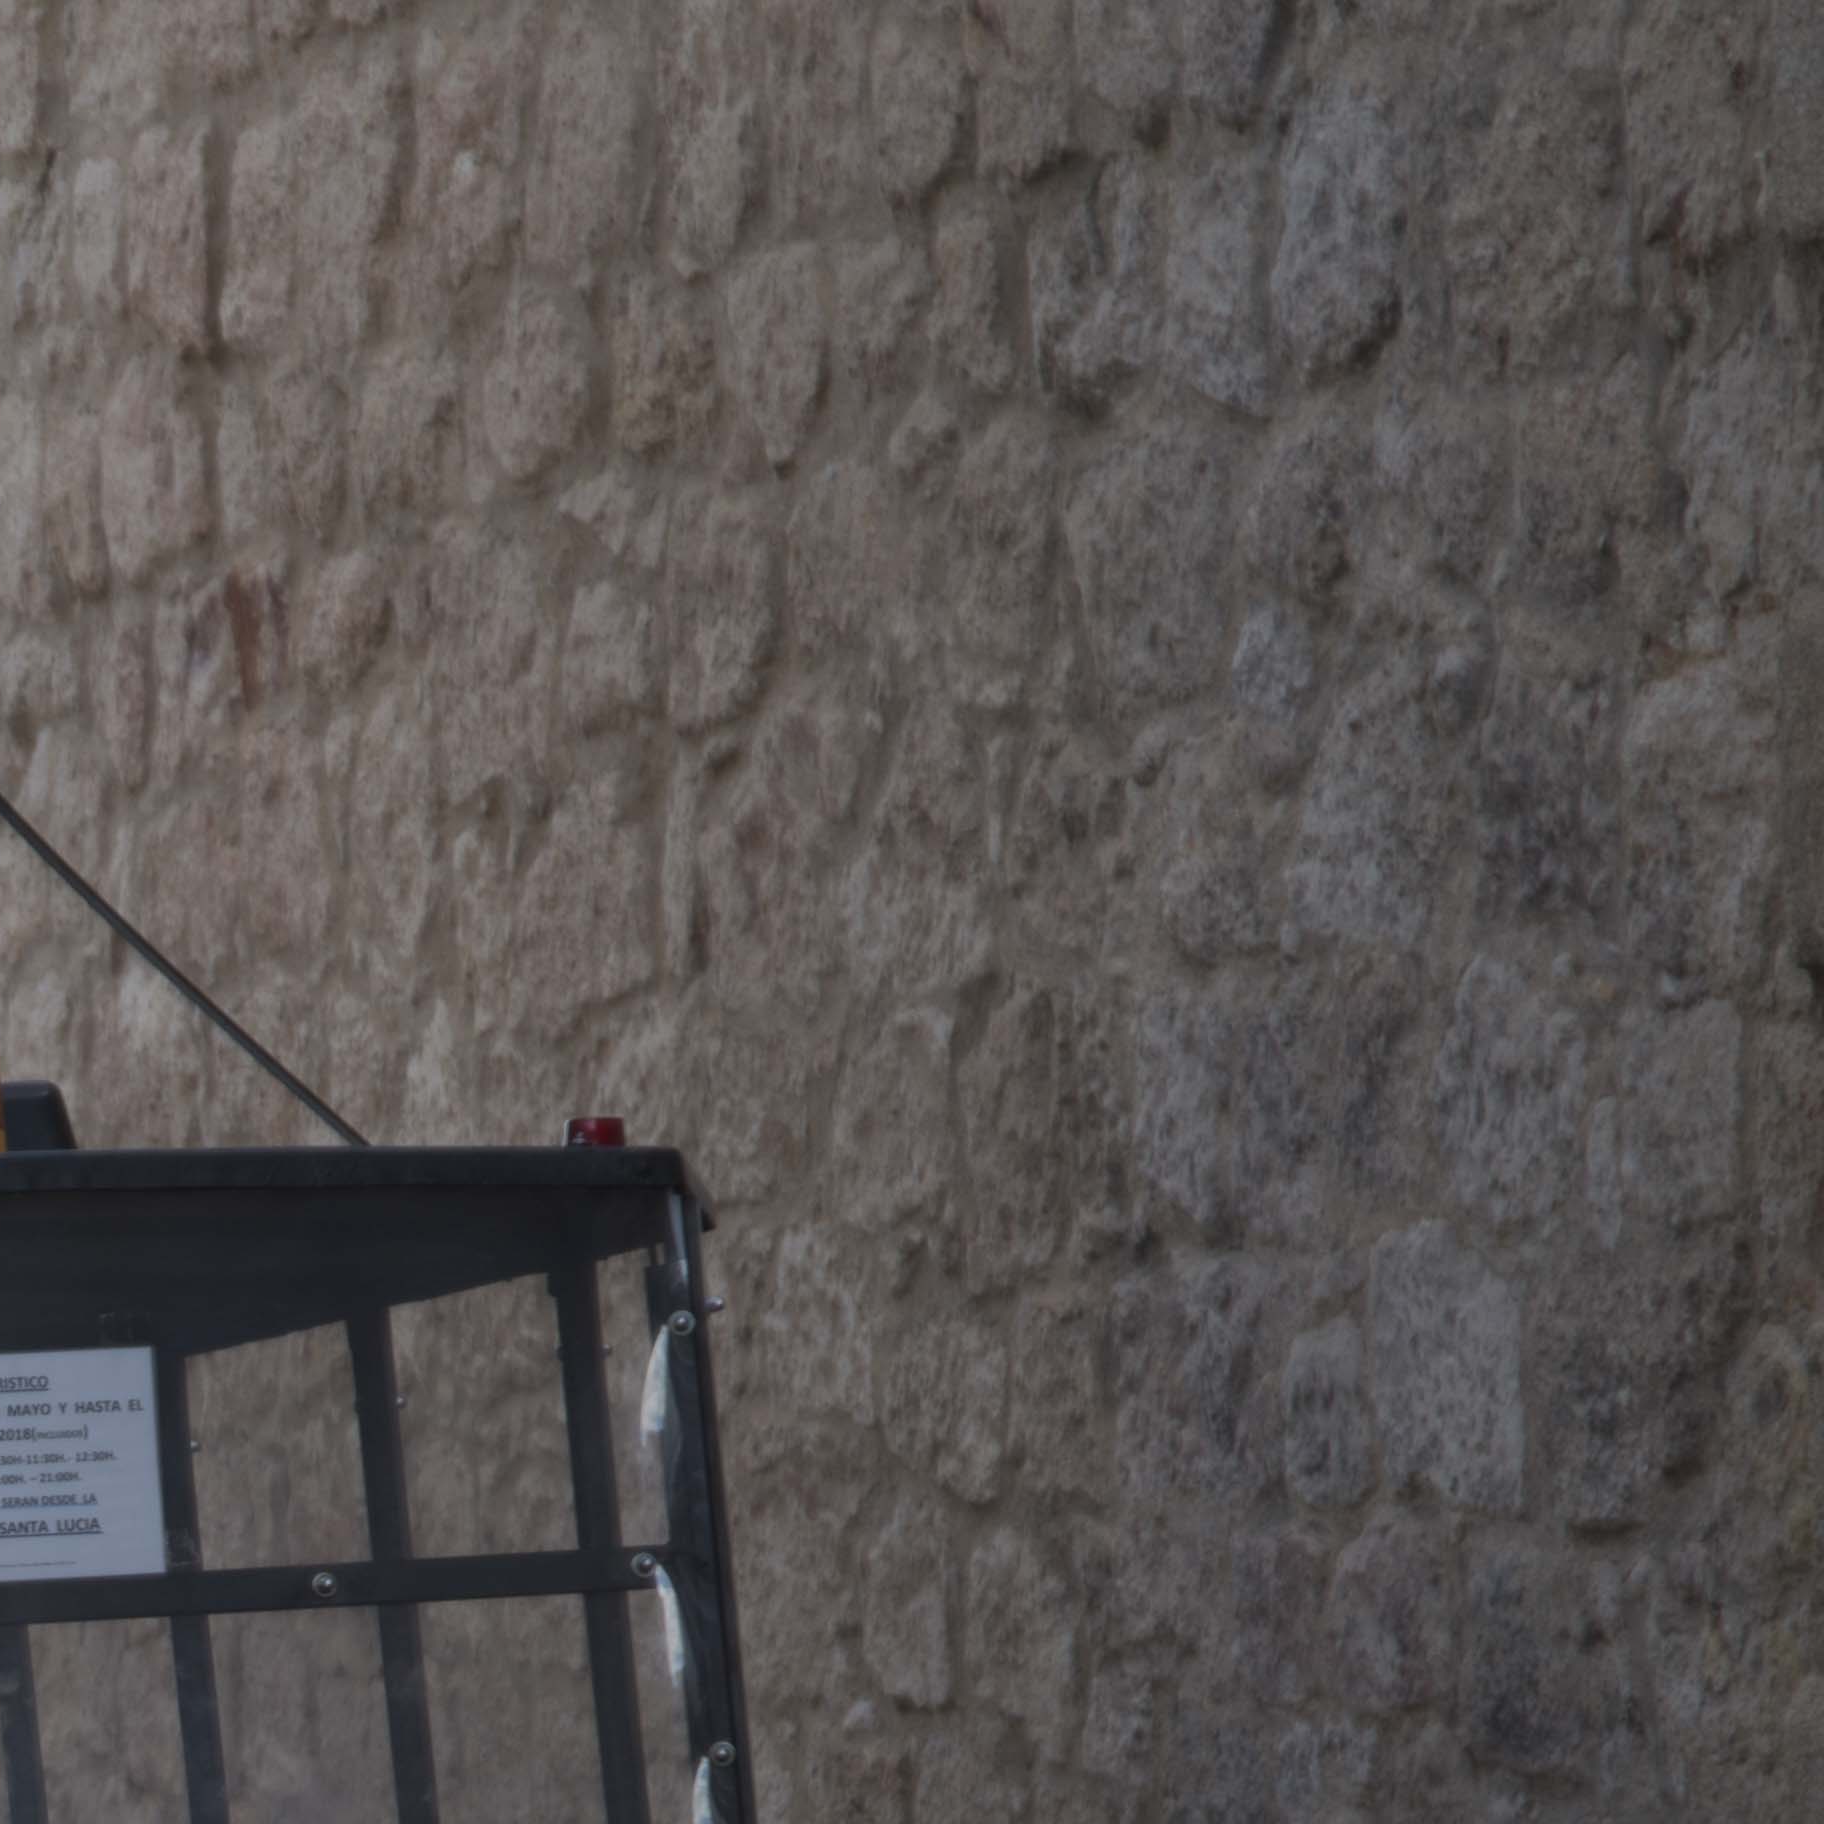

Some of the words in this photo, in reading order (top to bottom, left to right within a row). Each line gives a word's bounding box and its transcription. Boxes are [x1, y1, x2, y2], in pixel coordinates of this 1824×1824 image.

[7, 1403, 50, 1418] MAYO
[58, 1402, 67, 1415] Y
[75, 1399, 121, 1414] HASTA
[128, 1399, 144, 1411] EL
[1, 1496, 39, 1509] SERAN
[41, 1493, 78, 1507] DESDE
[82, 1493, 97, 1505] LA
[0, 1520, 49, 1536] SANTA
[57, 1518, 100, 1533] LUCIA
